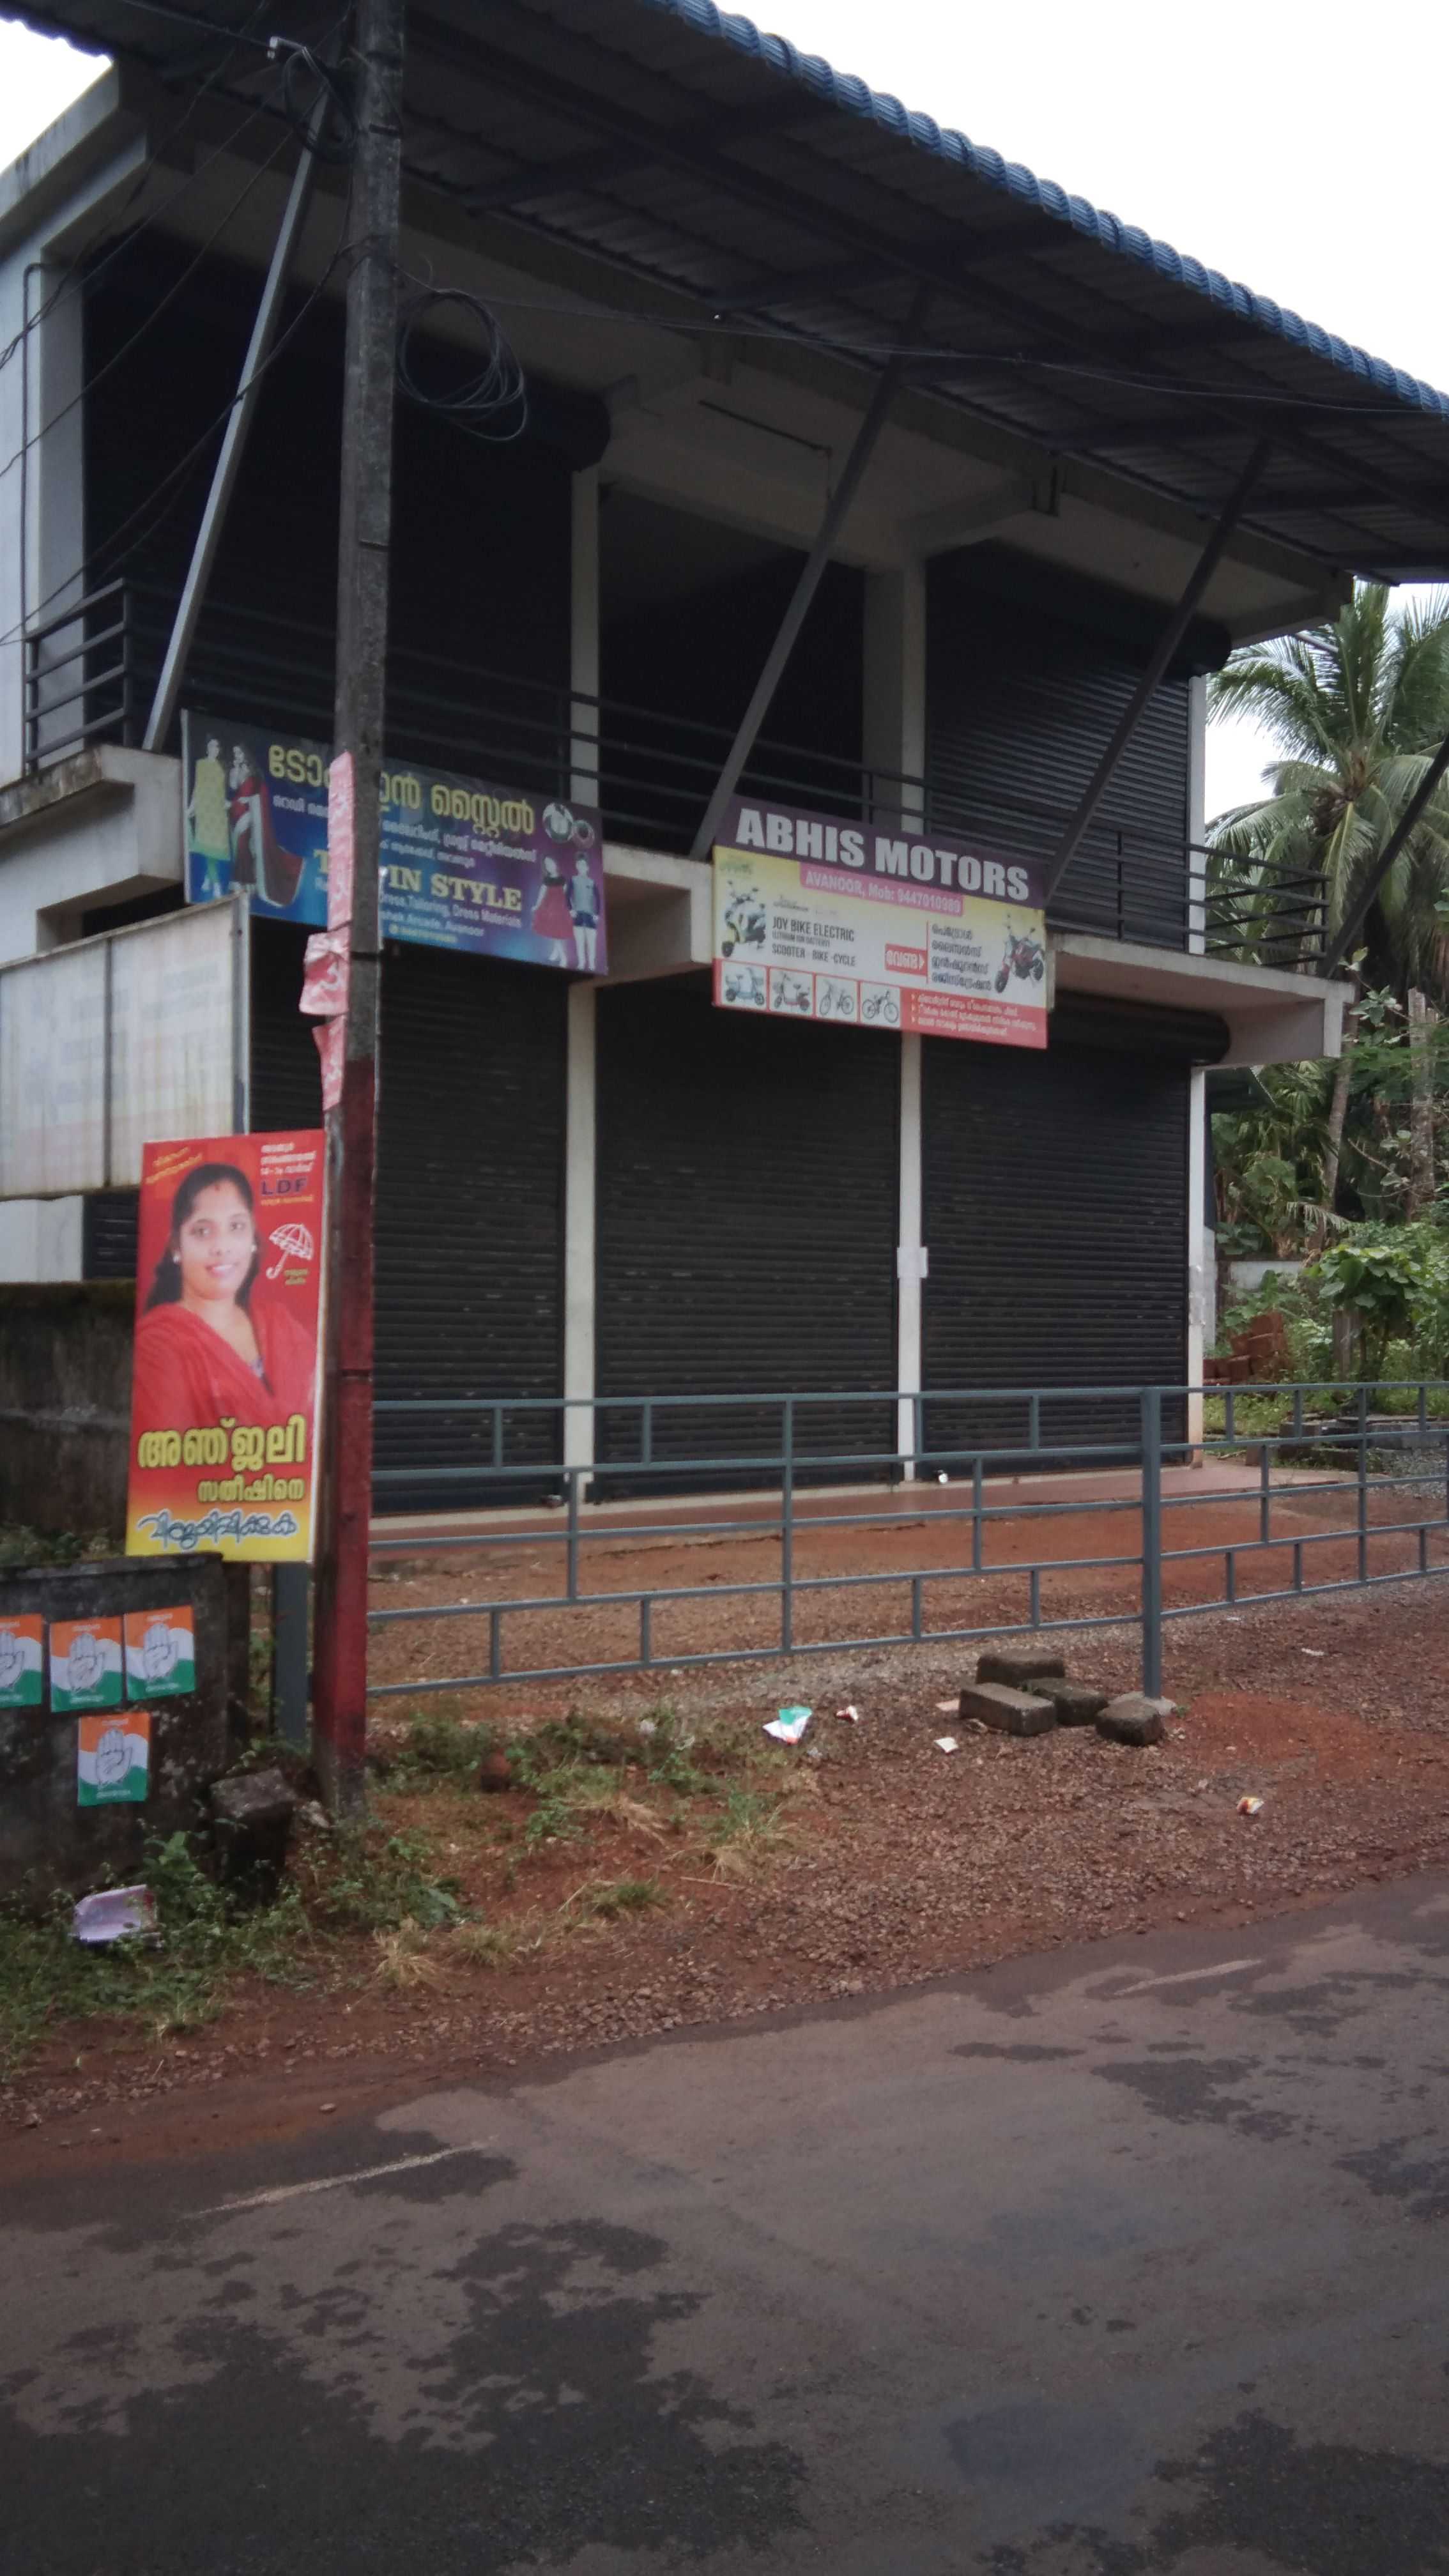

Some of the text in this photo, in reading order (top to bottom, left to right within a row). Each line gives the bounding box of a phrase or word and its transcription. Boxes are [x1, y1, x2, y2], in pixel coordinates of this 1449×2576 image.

[736, 808, 1030, 901] ABHIS MOTORS
[387, 864, 522, 911] IN STYLE
[772, 916, 854, 942] JOY BIKE ELECTRIC
[772, 944, 855, 967] SCOOTER BIKE CYCLE
[261, 1176, 307, 1196] LDF
[138, 1414, 307, 1471] അഞ്ജലി
